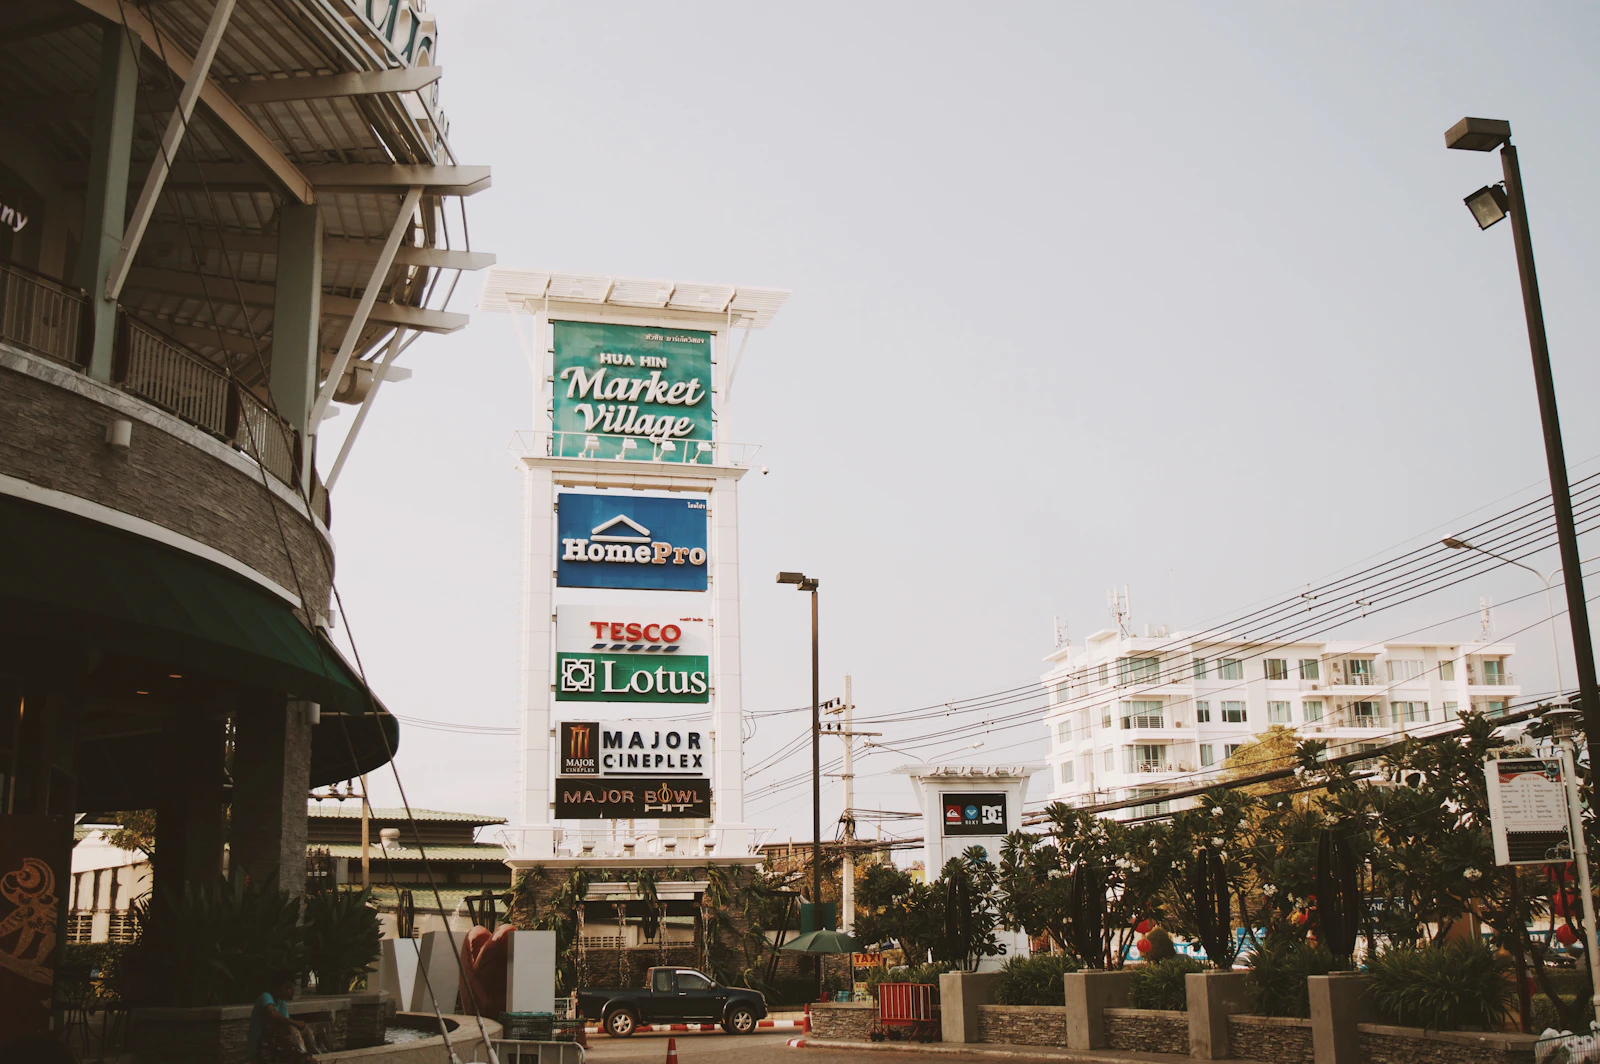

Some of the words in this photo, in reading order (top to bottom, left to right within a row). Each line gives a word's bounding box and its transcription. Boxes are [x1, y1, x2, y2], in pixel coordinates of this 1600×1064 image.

[0, 202, 28, 232] ny
[600, 352, 635, 367] HUA
[640, 355, 668, 369] HIN
[560, 366, 705, 406] Market
[575, 403, 695, 444] Village
[562, 538, 706, 566] HomePro
[590, 621, 682, 643] TESCO
[601, 660, 707, 694] Lotus
[603, 731, 701, 750] MAJOR
[566, 758, 595, 768] MAJOR
[603, 754, 703, 768] CINEPLEX
[563, 790, 635, 804] MAJOR
[644, 783, 703, 804] BOWL
[854, 954, 881, 963] TAXI
